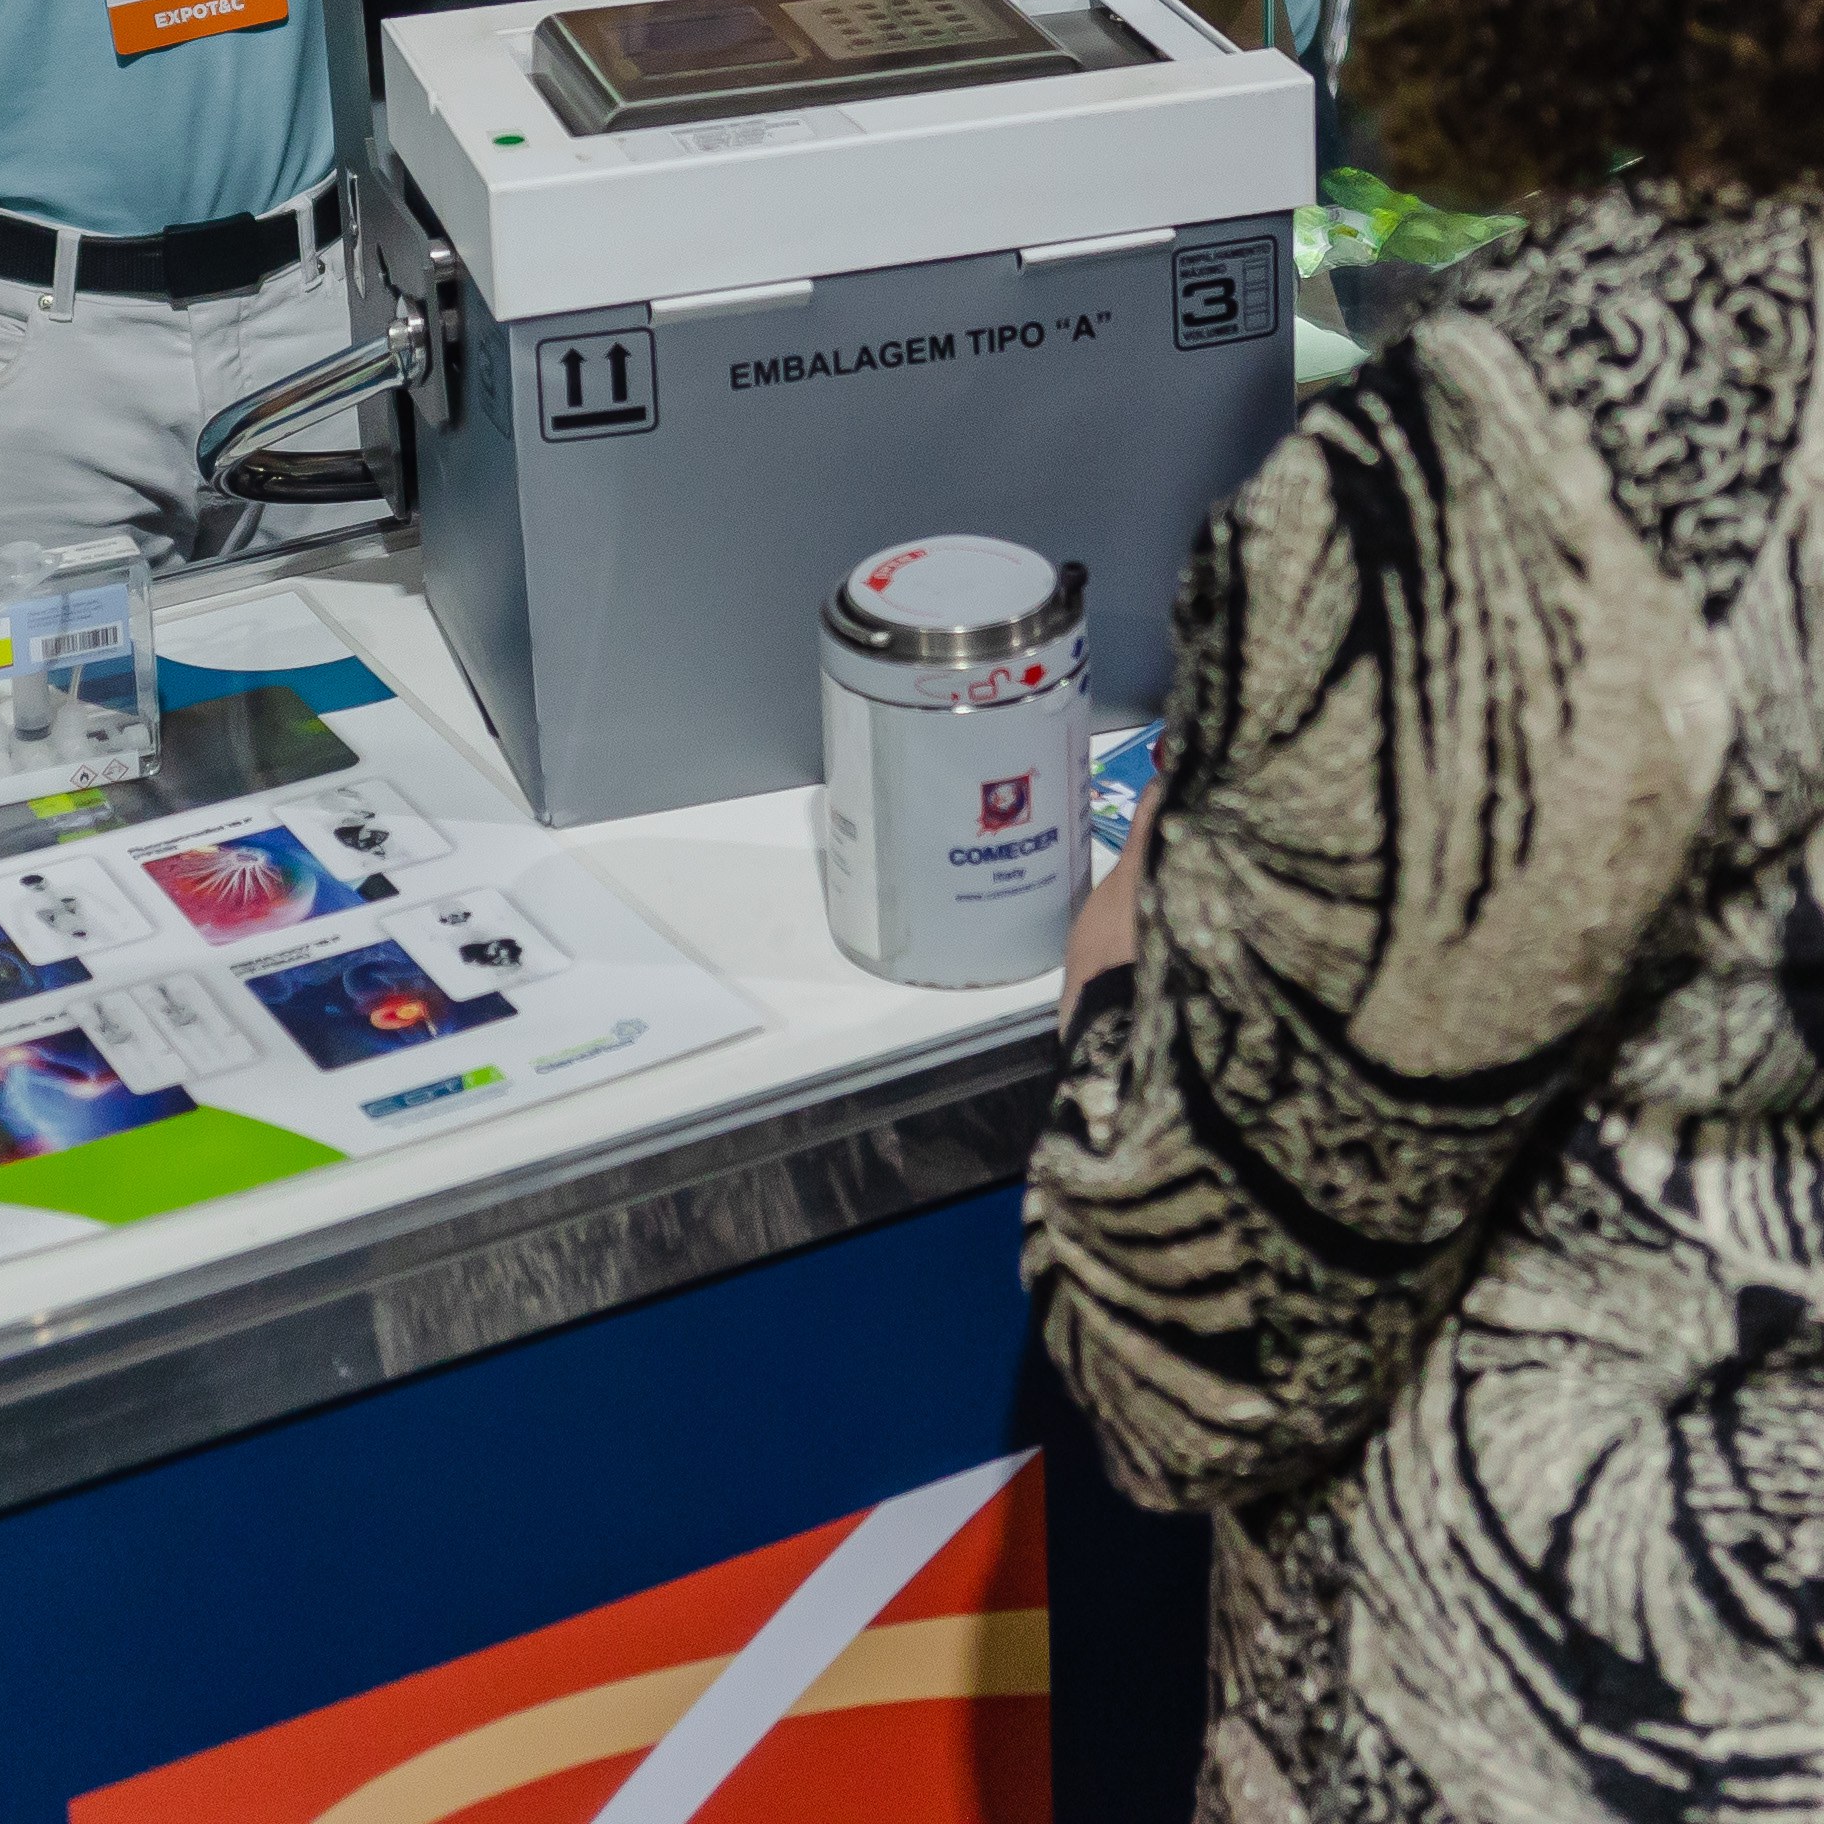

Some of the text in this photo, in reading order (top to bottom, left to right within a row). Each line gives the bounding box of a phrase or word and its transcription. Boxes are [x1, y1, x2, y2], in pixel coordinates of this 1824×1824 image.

[1182, 278, 1239, 327] 3
[729, 333, 956, 391] EMBALAGEM
[966, 321, 1045, 356] TIPO
[948, 826, 1058, 866] COMECER
